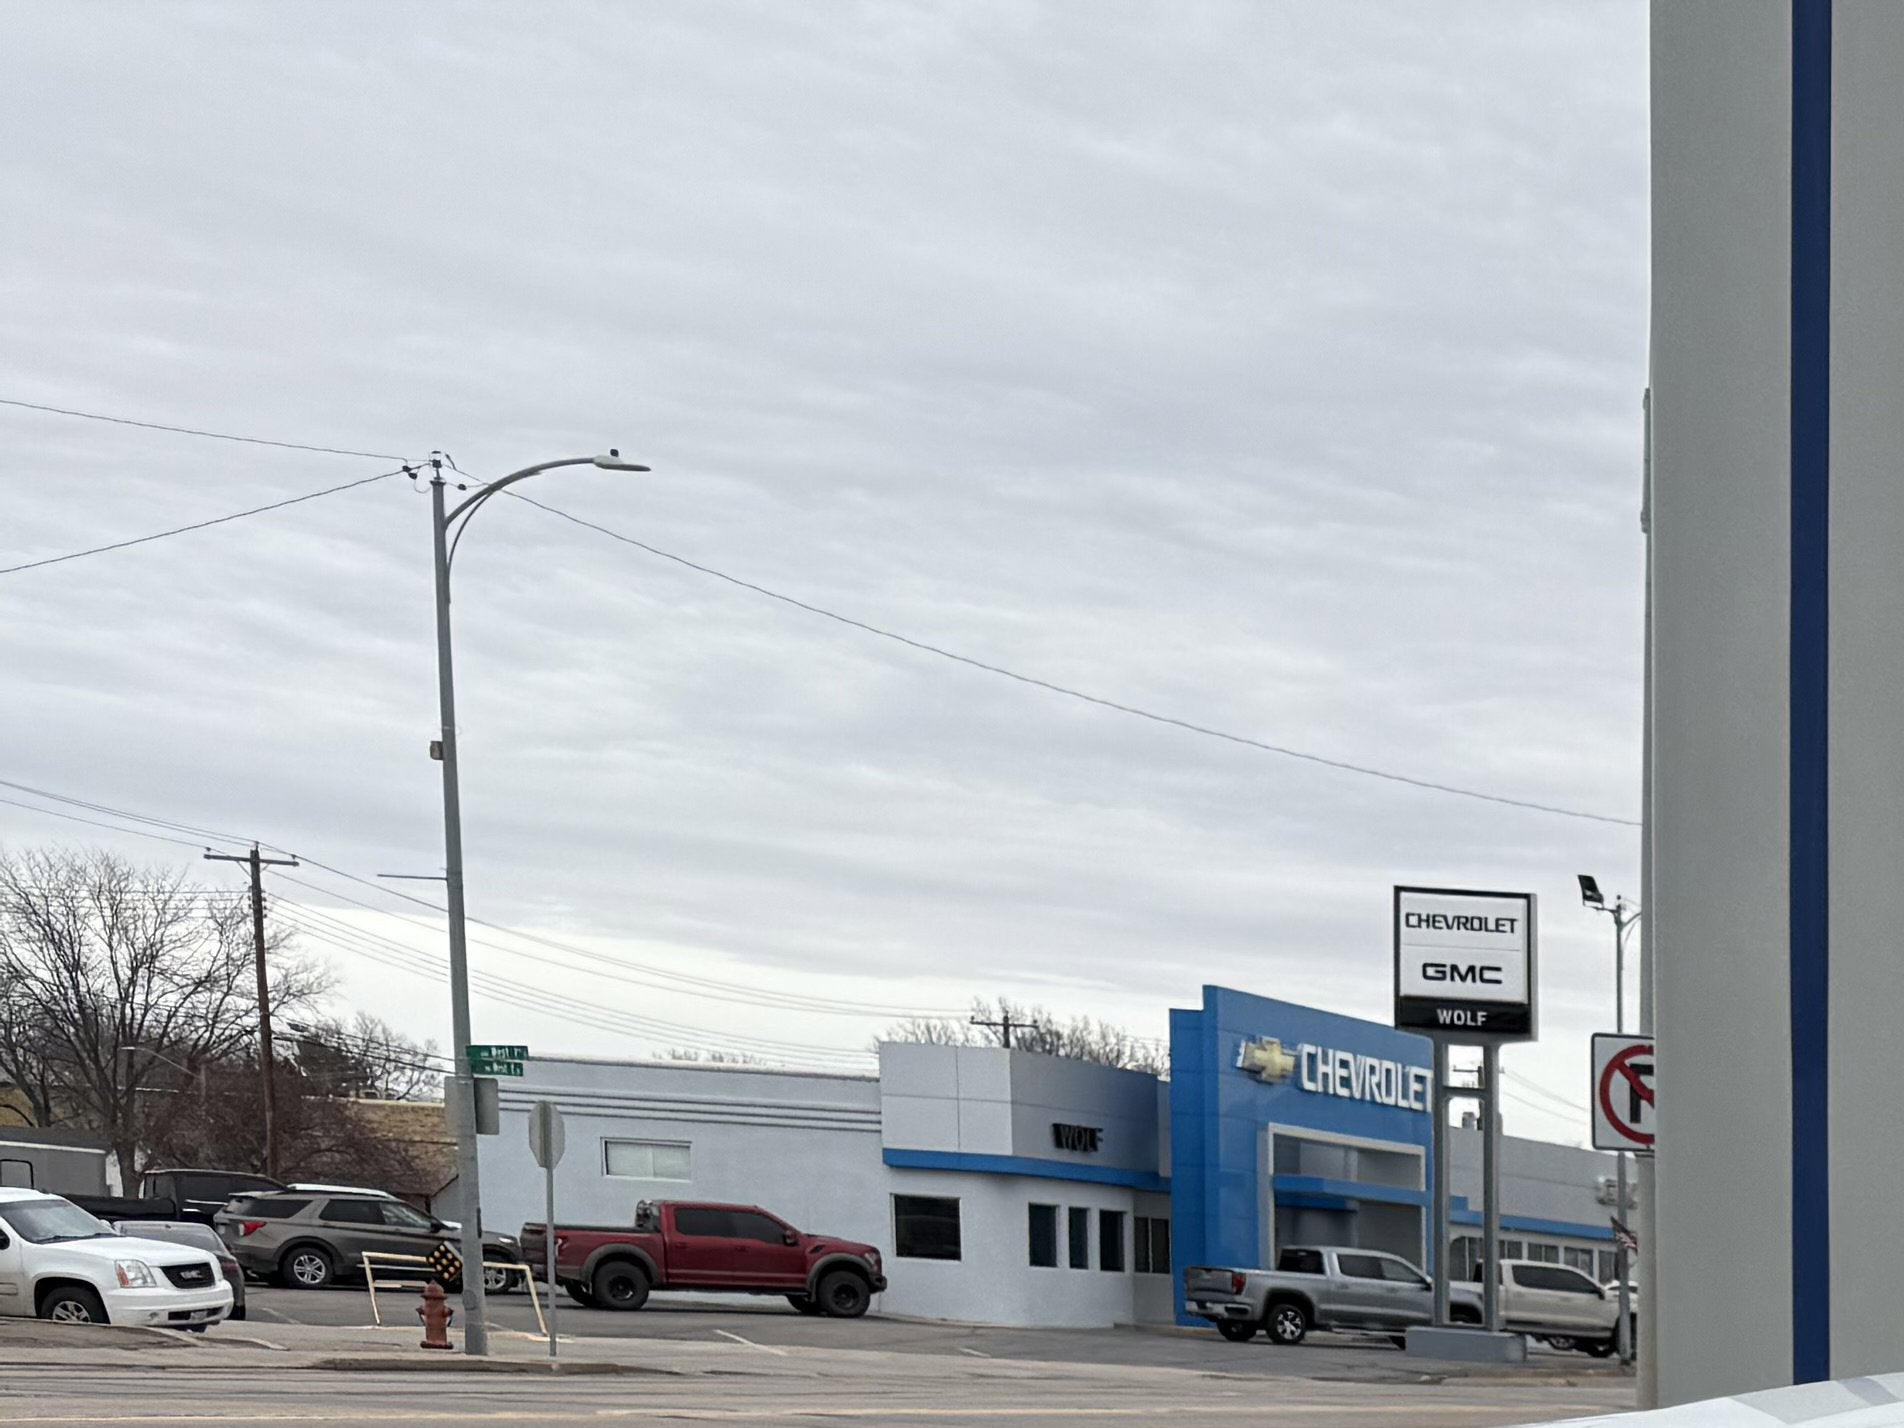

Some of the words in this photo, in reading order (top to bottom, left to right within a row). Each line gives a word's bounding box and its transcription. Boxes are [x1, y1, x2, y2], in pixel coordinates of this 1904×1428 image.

[1405, 912, 1519, 934] CHEVROLET
[1422, 963, 1502, 984] GMC
[1436, 1008, 1488, 1026] WOLF
[1300, 1043, 1434, 1113] CHEVROLET
[1052, 1123, 1104, 1152] WOLF
